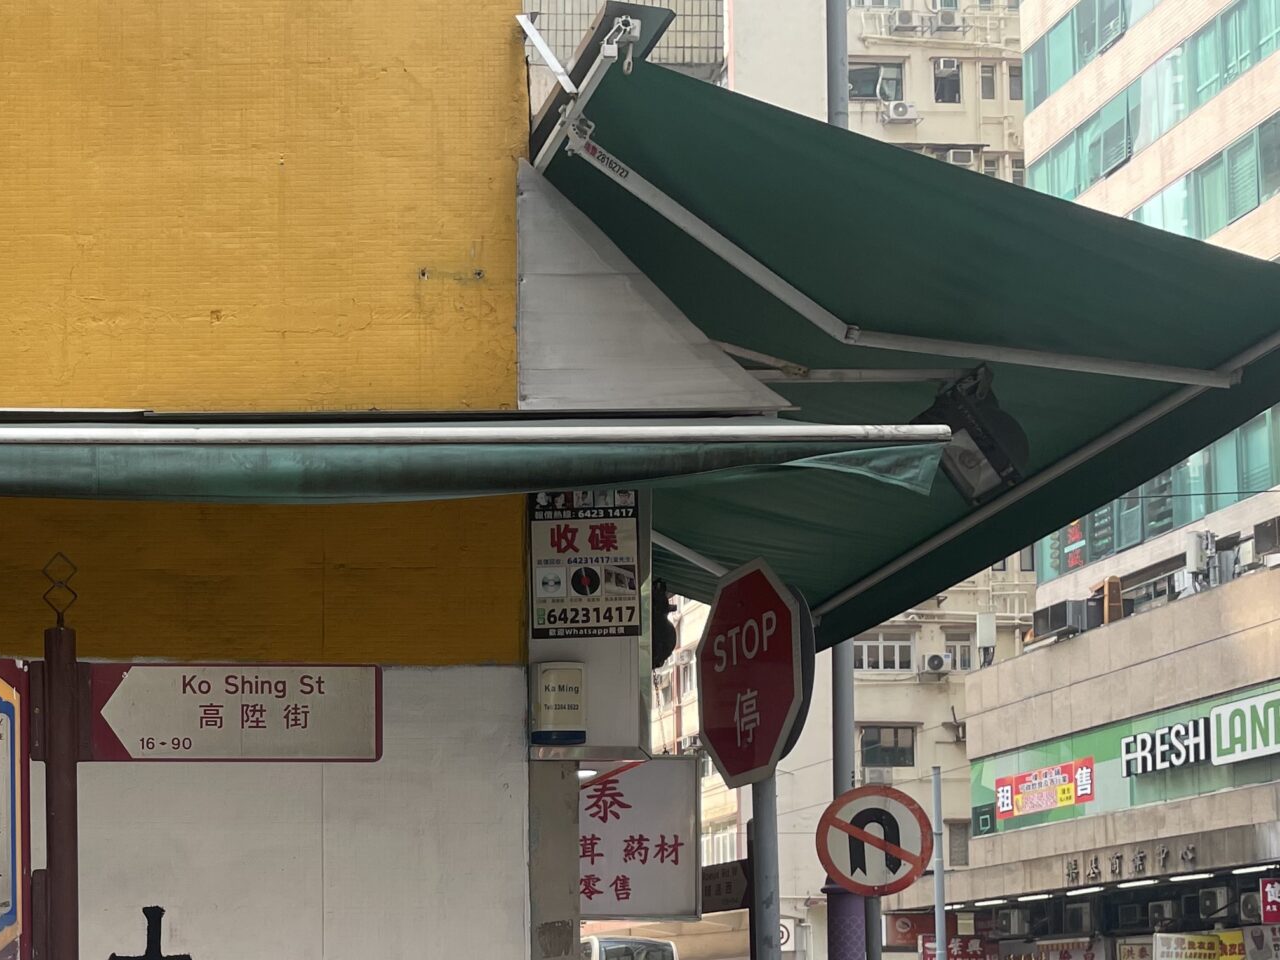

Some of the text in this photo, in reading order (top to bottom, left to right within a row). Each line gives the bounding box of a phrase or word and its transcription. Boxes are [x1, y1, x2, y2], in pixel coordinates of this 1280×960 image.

[578, 509, 604, 518] 6423
[608, 508, 634, 517] 1417
[550, 522, 619, 554] 收碟
[547, 606, 635, 625] 64231417
[714, 610, 777, 673] STOP
[181, 674, 325, 698] Ko Shing St
[544, 684, 580, 695] Ka Ming
[198, 703, 310, 730] 高陞街
[734, 688, 761, 748] 停
[1121, 717, 1208, 778] FRESH
[1075, 766, 1092, 797] 售
[585, 779, 632, 823] 泰
[997, 785, 1013, 813] 租
[580, 874, 632, 901] 零售
